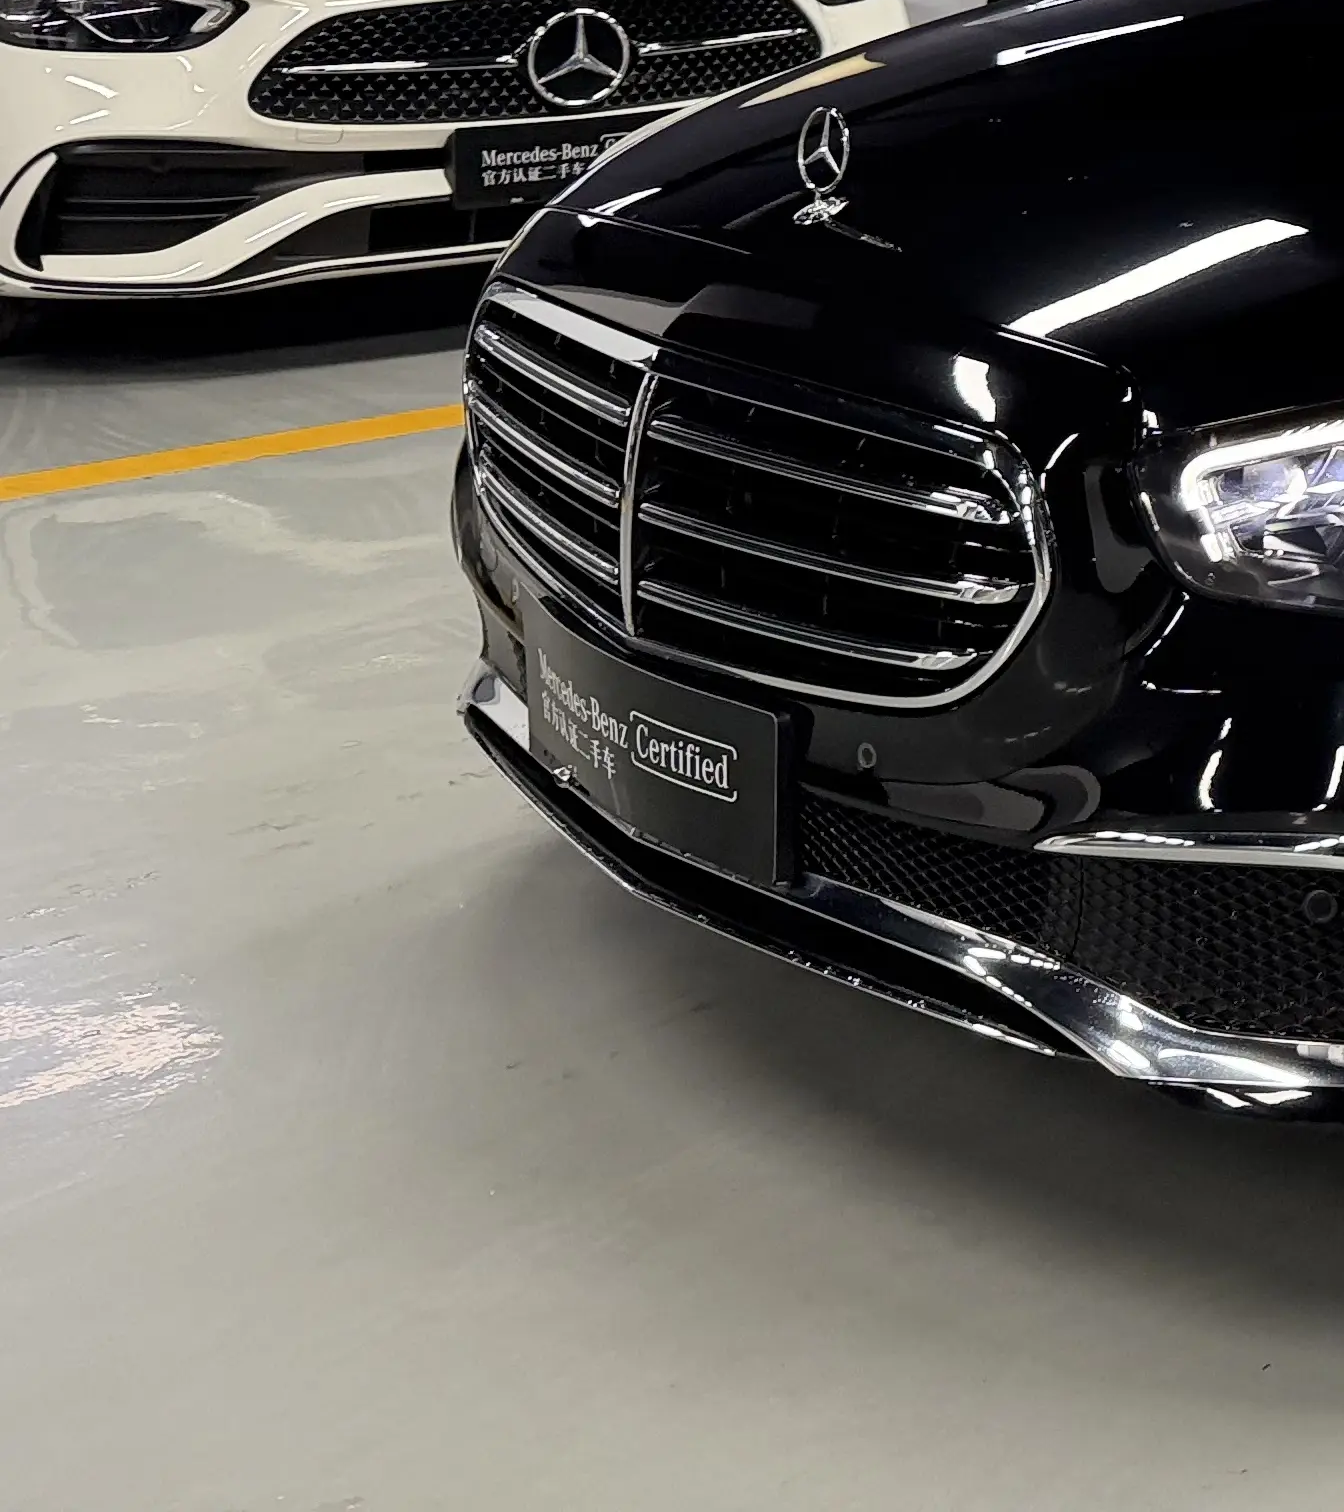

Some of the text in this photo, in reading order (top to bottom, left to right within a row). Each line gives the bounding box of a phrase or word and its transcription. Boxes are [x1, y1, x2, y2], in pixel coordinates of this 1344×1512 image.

[481, 143, 600, 168] Mercedes-Benz
[481, 161, 587, 187] 官方认证二手车
[537, 647, 730, 790] Mercedes-Benz Certified
[541, 689, 617, 780] 官方认证二手车
